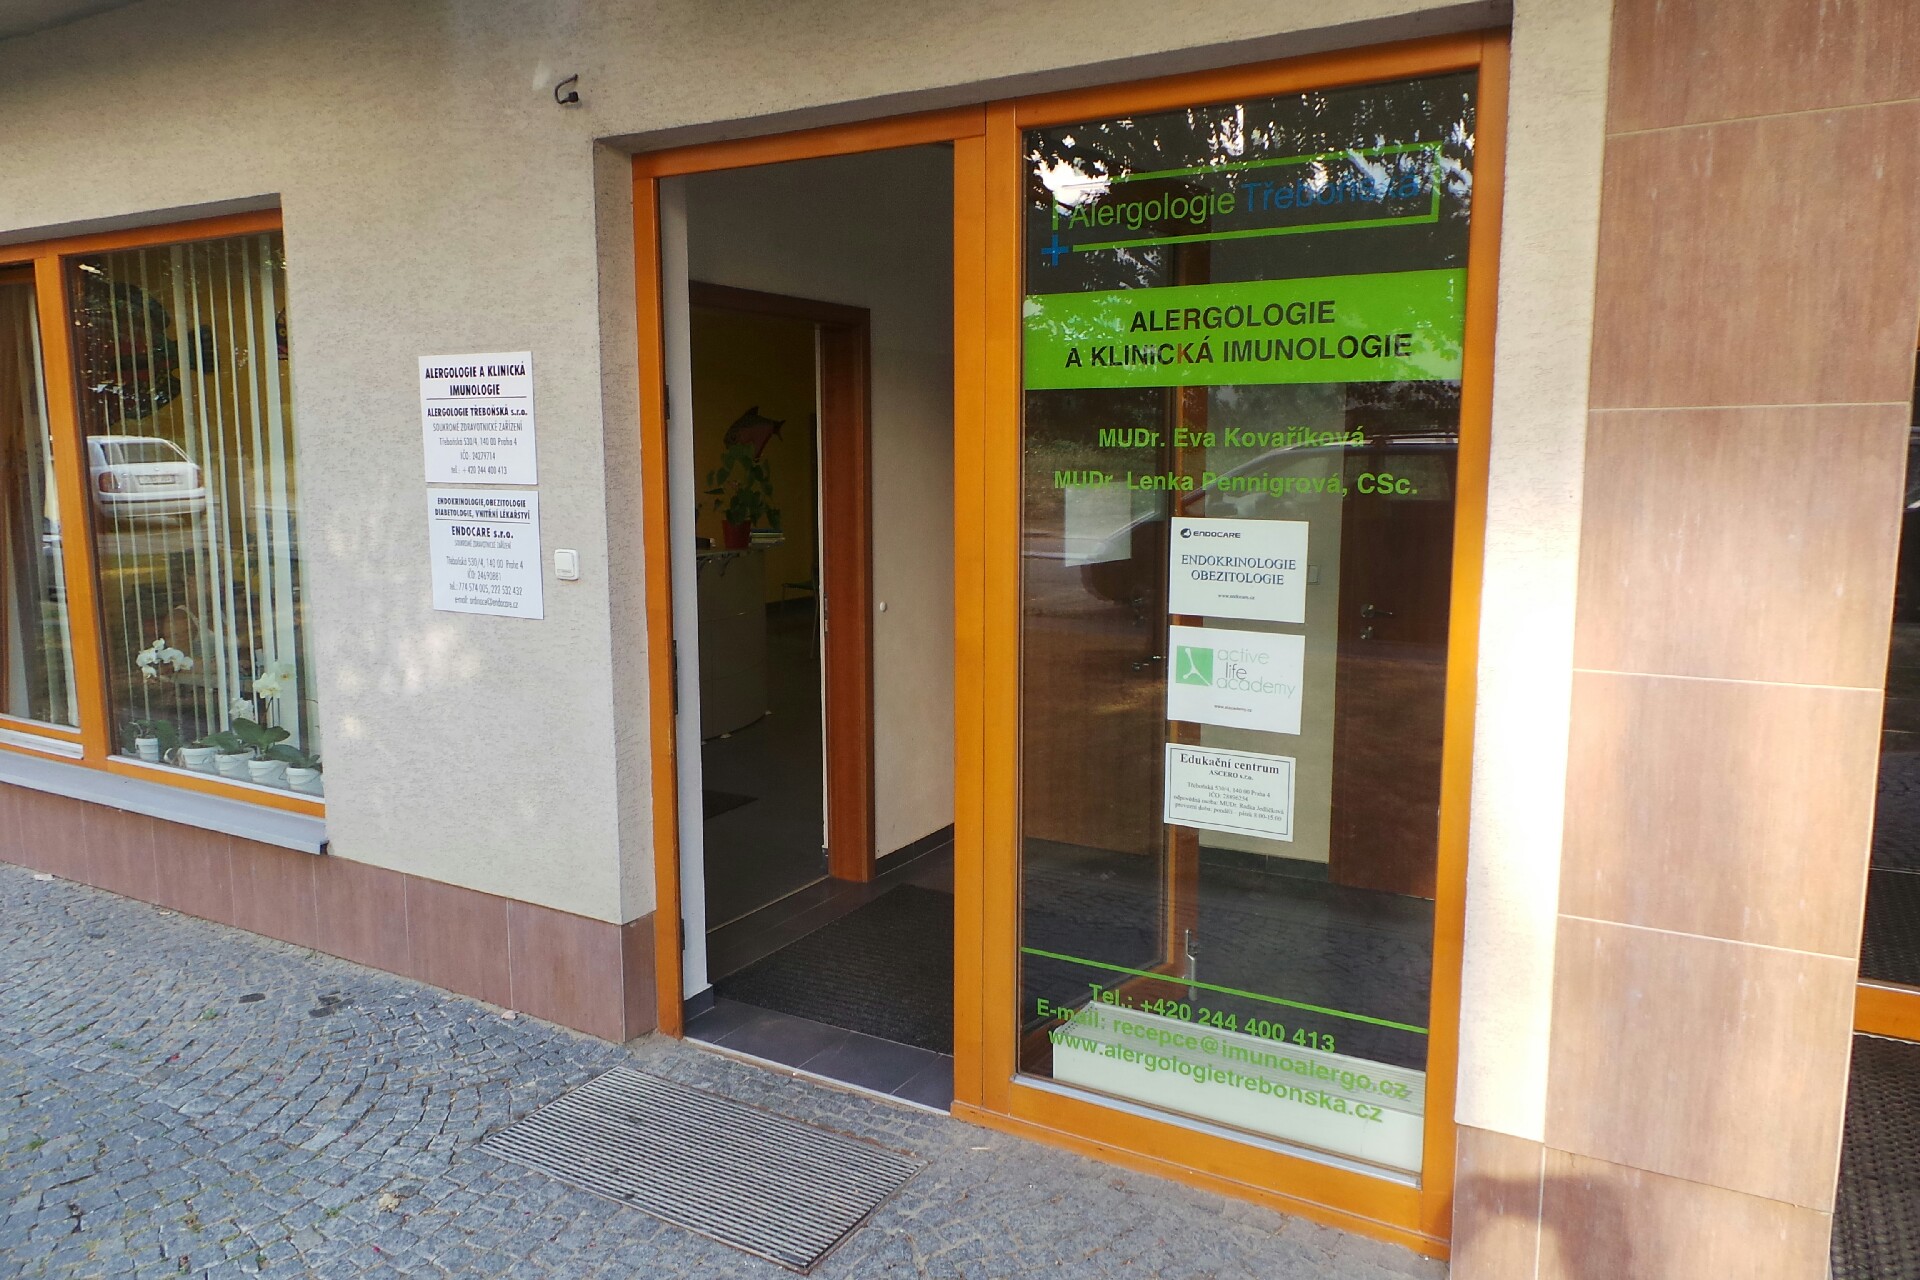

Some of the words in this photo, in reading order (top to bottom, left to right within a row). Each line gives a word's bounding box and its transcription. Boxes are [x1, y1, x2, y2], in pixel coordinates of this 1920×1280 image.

[1069, 187, 1235, 232] Alergologie
[1130, 300, 1336, 333] ALERGOLOGIE
[1065, 347, 1082, 368] A
[1091, 335, 1213, 367] KLINICKÁ
[1223, 333, 1413, 363] IMUNOLOGIE
[425, 366, 477, 379] ALERGOLOGIE
[480, 366, 485, 377] A
[488, 361, 526, 377] KLINICKÁ
[450, 384, 500, 396] IMUNOLOGIE
[427, 407, 468, 417] ALERGOLOGIE
[470, 404, 508, 416] TŘEBOŇSKÁ
[510, 408, 528, 416] s.r.o.
[497, 437, 513, 446] Praha
[1098, 428, 1165, 448] MUDr.
[1173, 428, 1217, 448] Eva
[1224, 426, 1365, 448] Kovaříková
[477, 466, 486, 474] 244
[487, 466, 497, 475] 400
[497, 466, 507, 475] 413
[1126, 471, 1194, 491] Lenka
[1203, 472, 1348, 497] Pennigrová,
[1357, 473, 1418, 495] CSc.
[451, 526, 491, 538] ENDOCARE
[493, 530, 514, 539] s.r.o.
[1193, 530, 1241, 539] ENDOCARE
[519, 561, 524, 569] 4
[1181, 554, 1296, 570] ENDOKRINOLOGIE
[1191, 569, 1284, 586] OBEZITOLOGIE
[1217, 647, 1270, 665] active
[1225, 662, 1248, 680] life
[1217, 676, 1296, 699] academy
[1180, 753, 1232, 769] Edukační
[1234, 759, 1280, 775] centrum
[1208, 769, 1239, 779] ASCERO
[1088, 983, 1134, 1008] Tel.:
[1140, 999, 1192, 1023] +420
[1198, 1008, 1238, 1033] 244
[1244, 1018, 1286, 1042] 400
[1292, 1028, 1336, 1053] 413
[1036, 998, 1106, 1030] E-mail:
[1113, 1017, 1409, 1099] recepce@imunoalergo.cz
[1047, 1027, 1383, 1123] www.alergologietrebonska.cz
